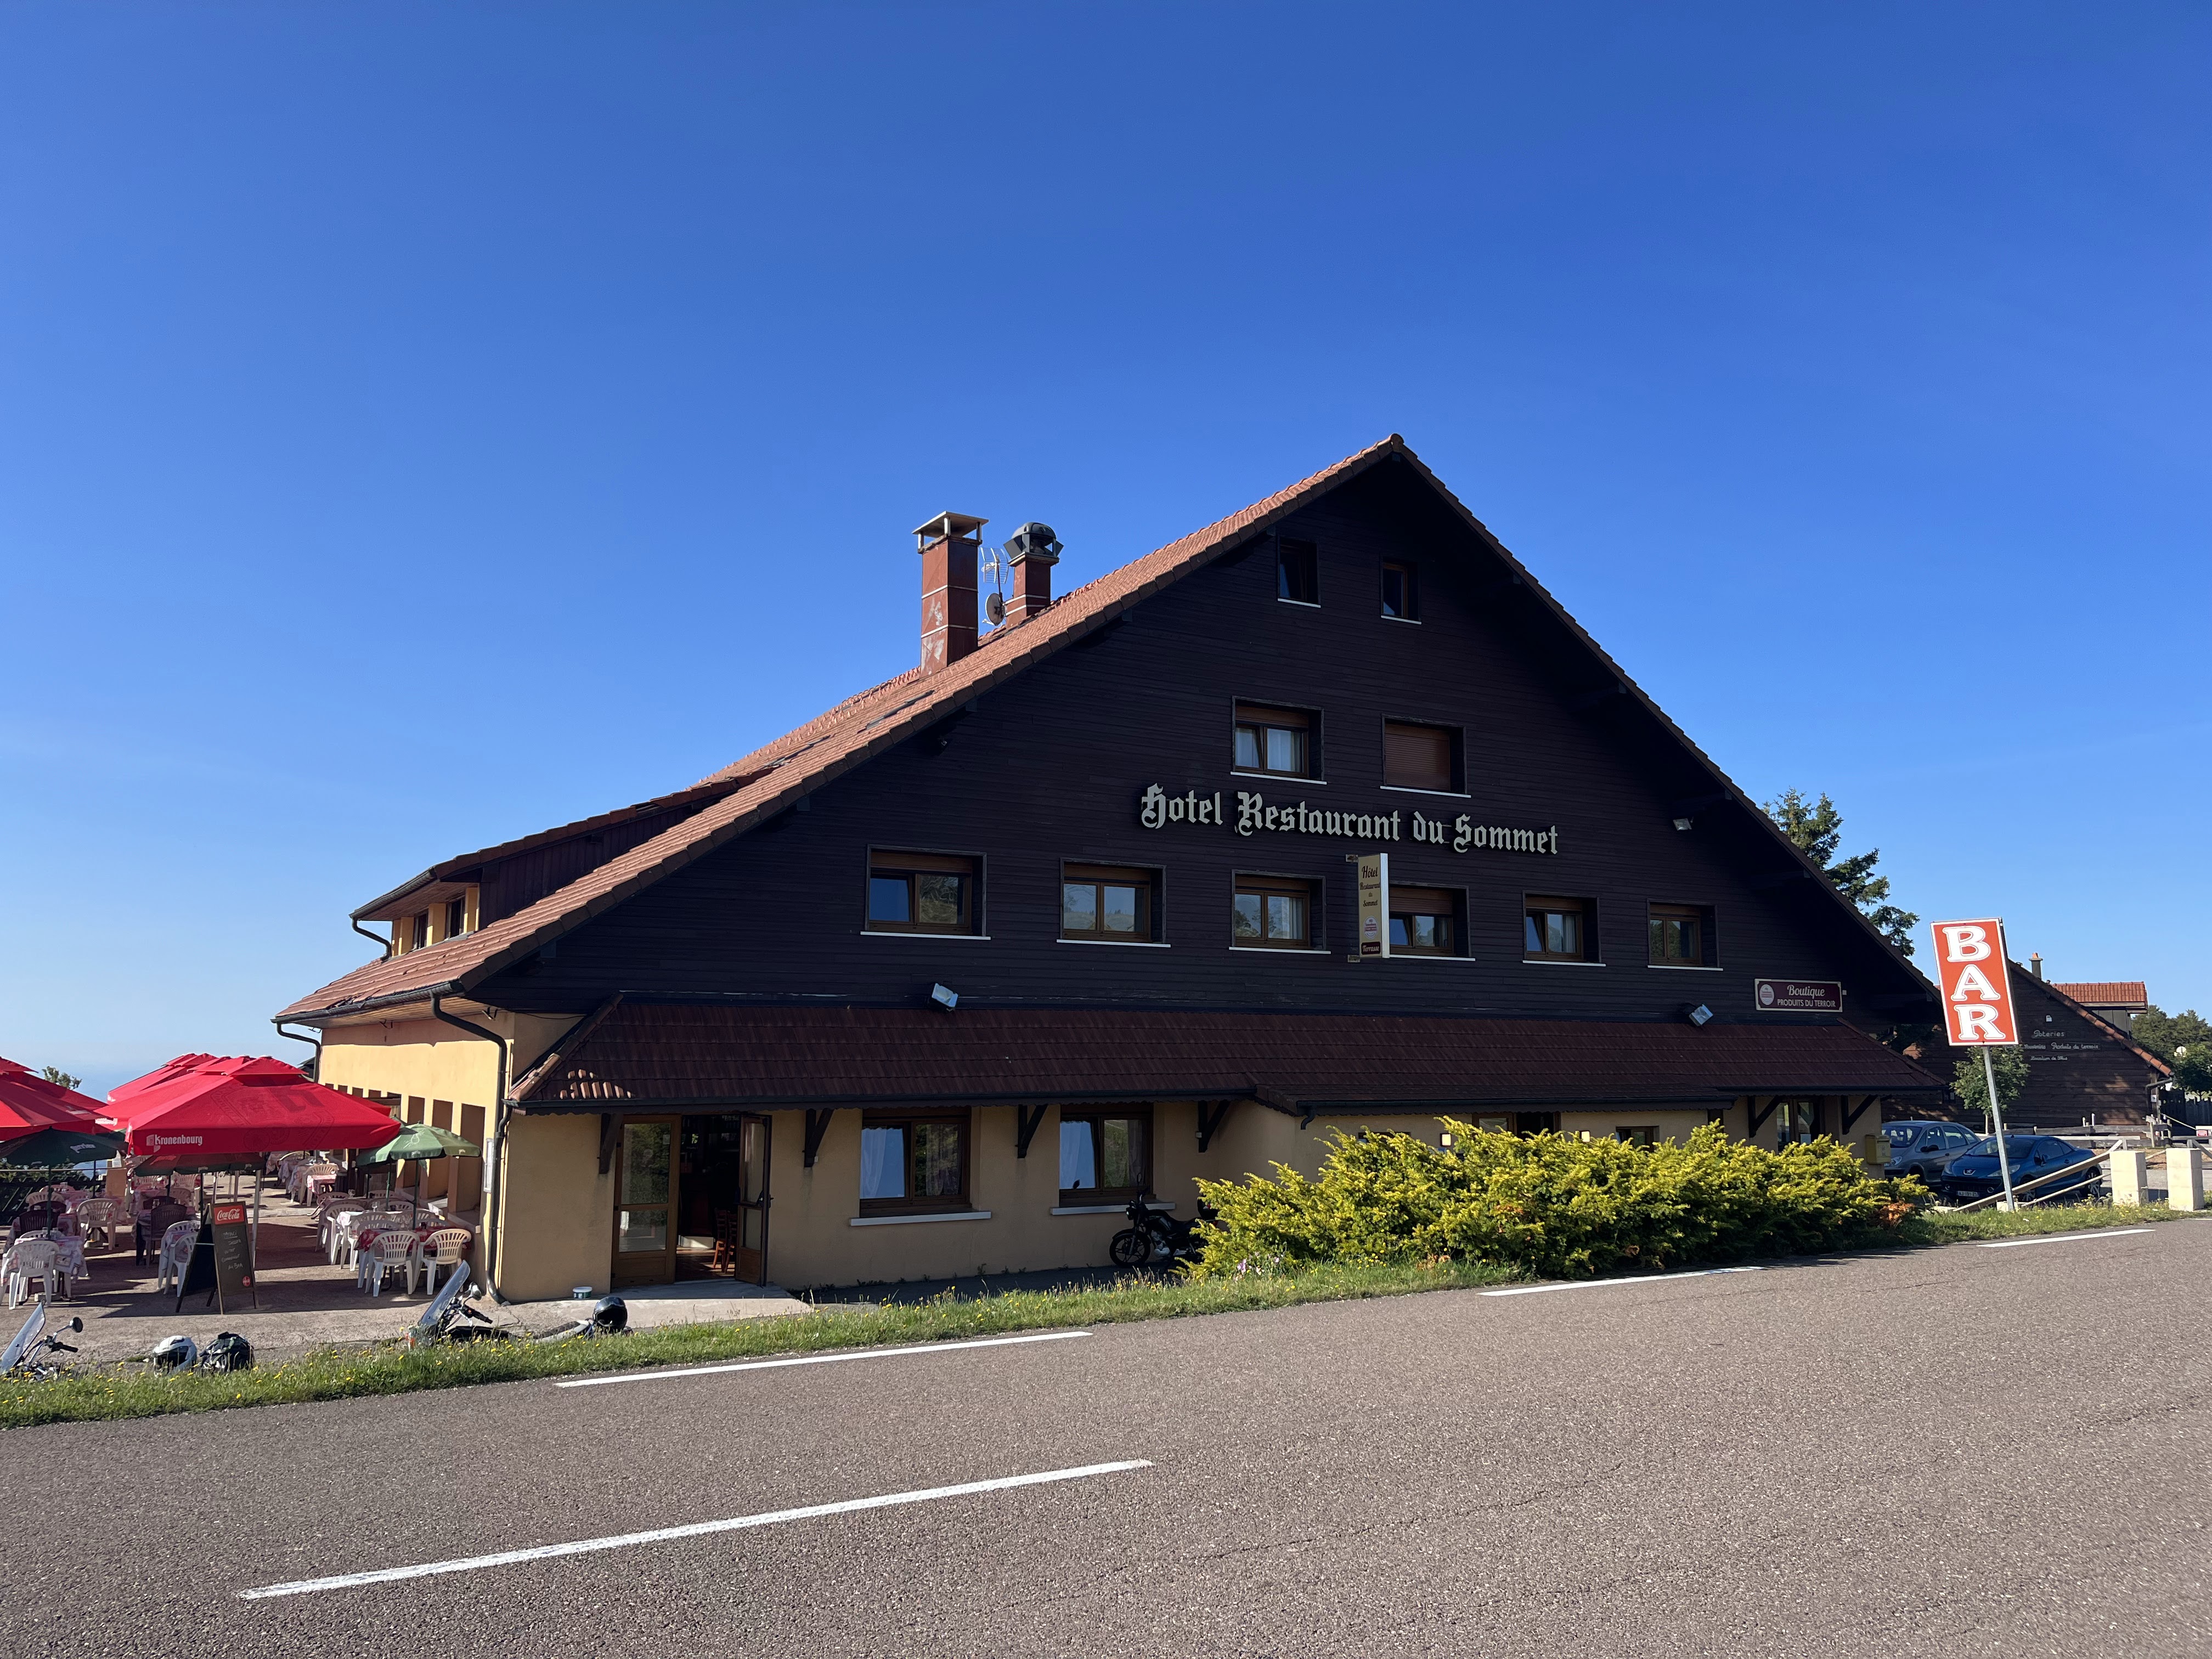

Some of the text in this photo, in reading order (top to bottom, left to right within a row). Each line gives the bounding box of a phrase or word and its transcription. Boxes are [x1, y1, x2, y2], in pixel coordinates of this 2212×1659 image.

[1141, 783, 1558, 854] Hotel Restaurant du Sommet
[1362, 866, 1378, 878] Hôtel
[1942, 926, 2006, 1040] BAR
[1787, 984, 1825, 999] Boutique
[1777, 998, 1804, 1007] PRODUITS
[155, 1134, 202, 1146] Kronenbourg
